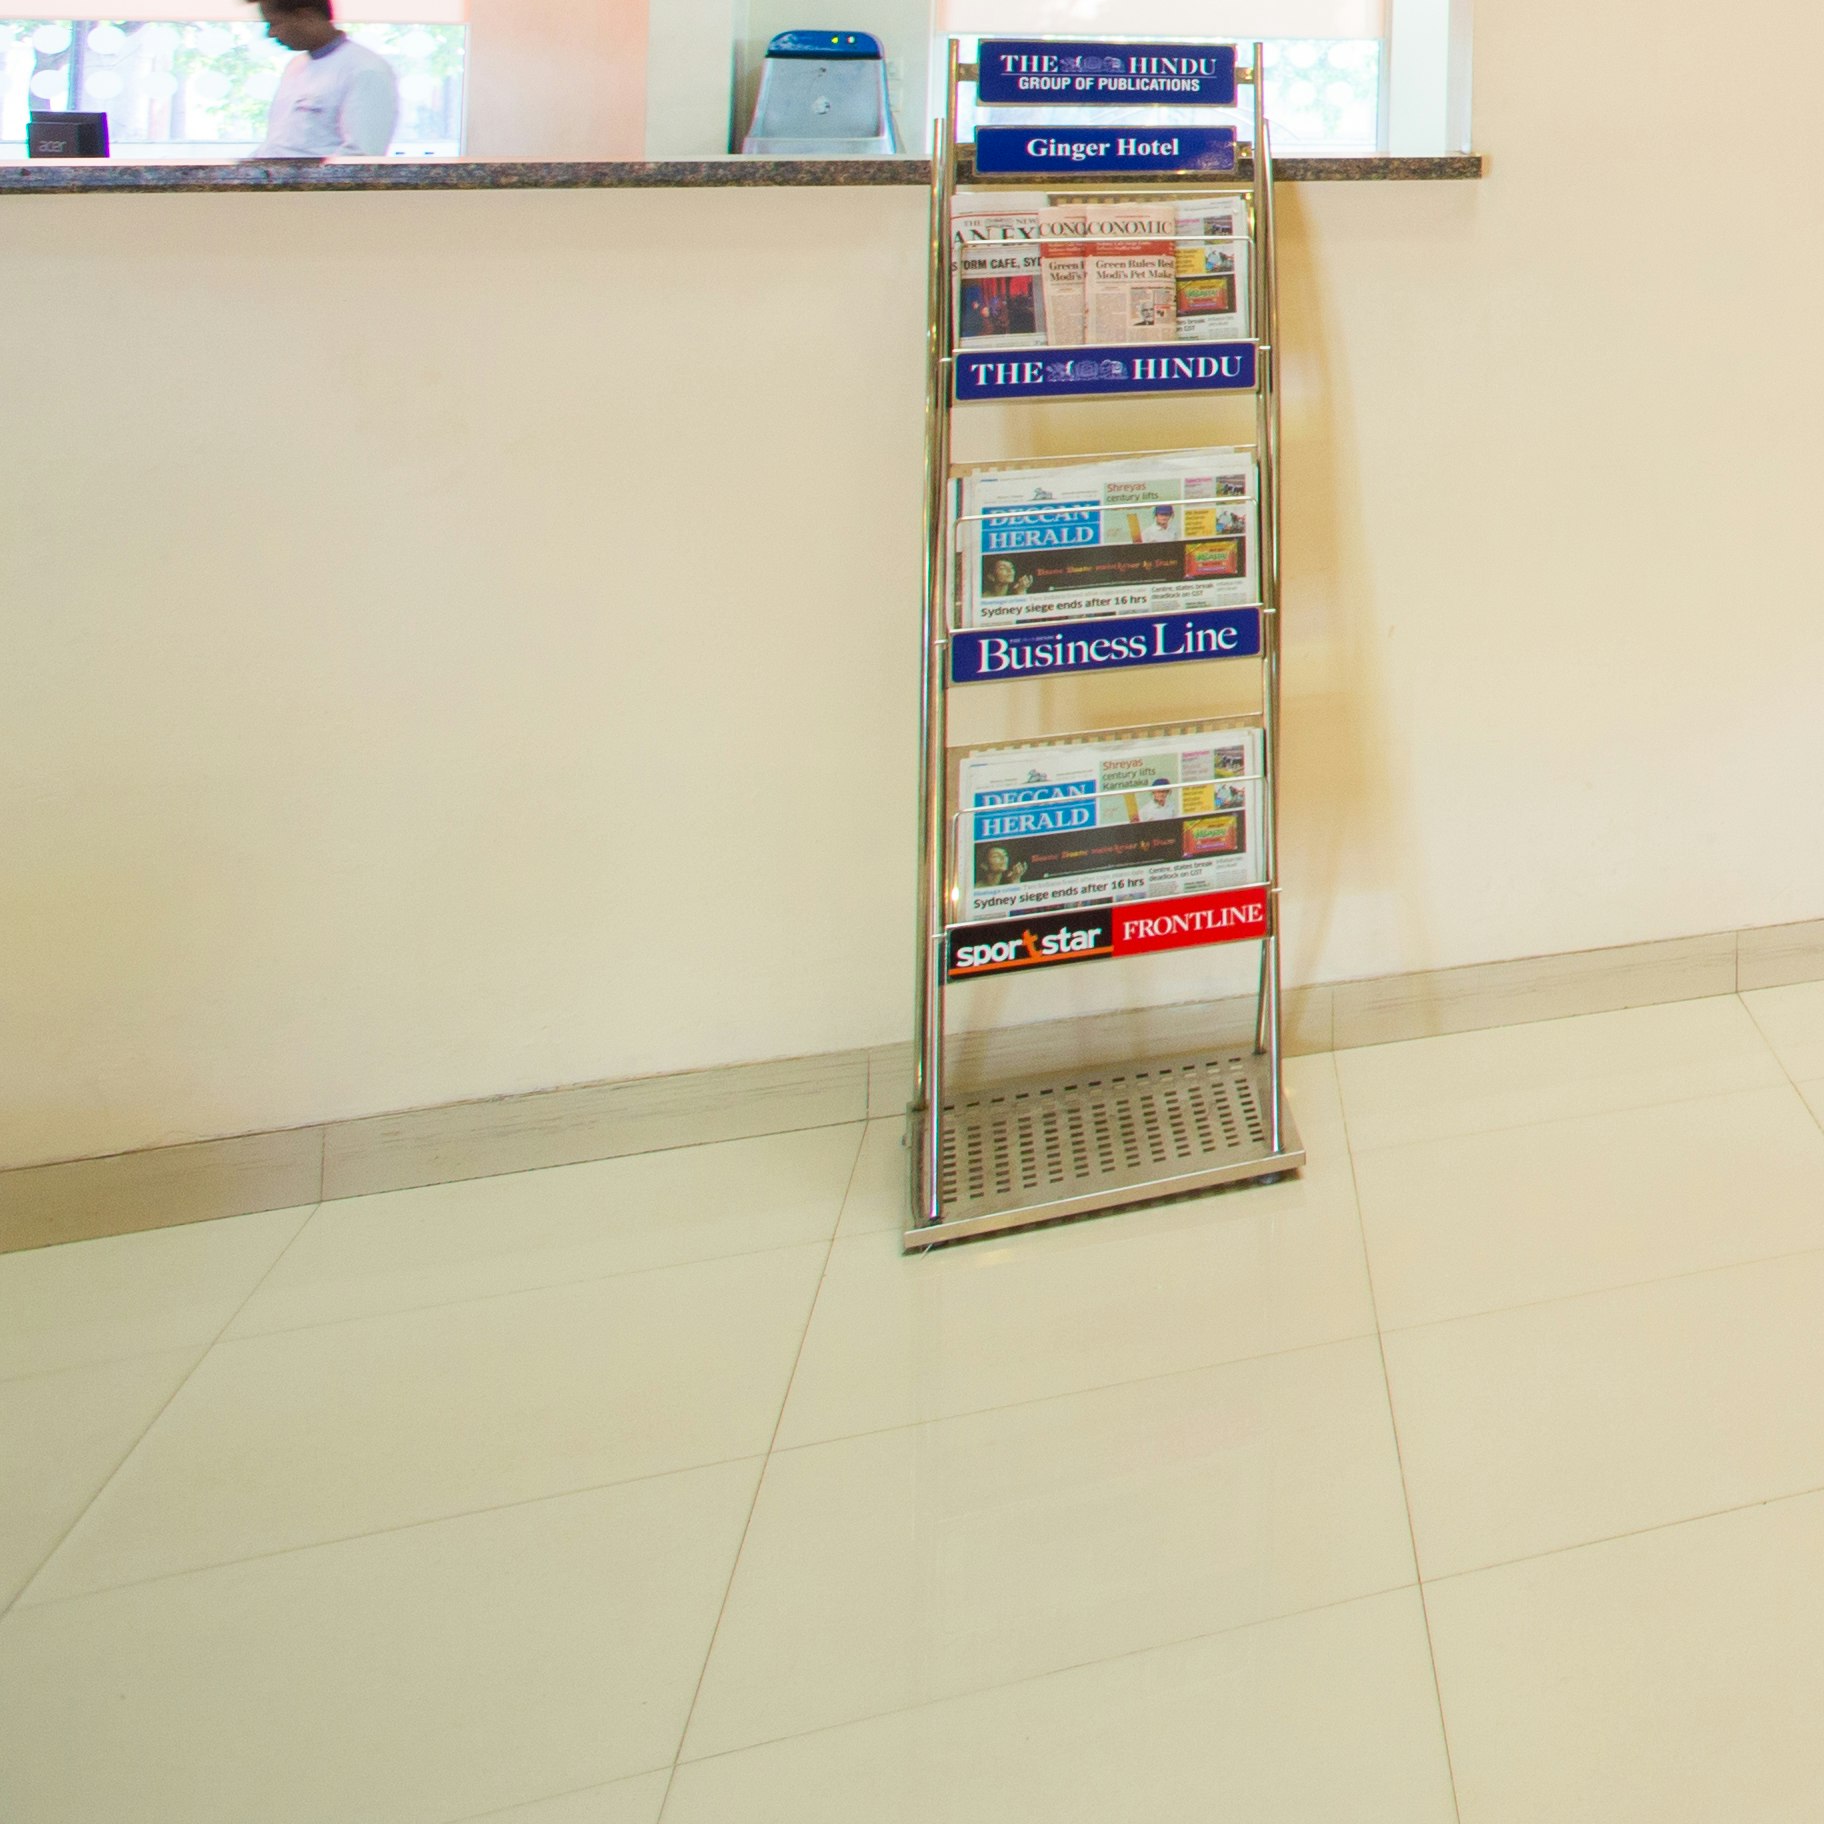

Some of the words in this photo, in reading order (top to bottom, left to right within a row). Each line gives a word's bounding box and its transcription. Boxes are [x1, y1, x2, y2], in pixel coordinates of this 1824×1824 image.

[1000, 55, 1058, 72] THE
[1129, 57, 1217, 75] HINDU
[1018, 77, 1071, 90] GROUP
[1075, 78, 1095, 90] OF
[1098, 78, 1200, 91] PUBLICATIONS
[1026, 138, 1110, 161] Ginger
[1117, 138, 1179, 156] Hotel
[971, 361, 1044, 386] THE
[1132, 356, 1242, 380] HINDU
[989, 504, 1091, 526] DECCAN
[989, 526, 1094, 549] HERALD
[981, 604, 1023, 617] Sydney
[1025, 603, 1054, 613] siege
[1056, 599, 1082, 610] ends
[1085, 596, 1111, 608] after
[1114, 596, 1127, 605] 16
[1130, 595, 1147, 604] hrs
[977, 633, 1147, 674] Business
[1152, 622, 1238, 657] Line
[982, 784, 1086, 806] DECCAN
[982, 808, 1089, 836] HERALD
[974, 894, 1016, 909] Sydney
[1019, 890, 1049, 903] siege
[1051, 886, 1078, 898] ends
[1080, 882, 1108, 894] after
[1111, 880, 1124, 890] 16
[1127, 878, 1145, 887] hrs
[1123, 903, 1263, 941] FRONTLINE
